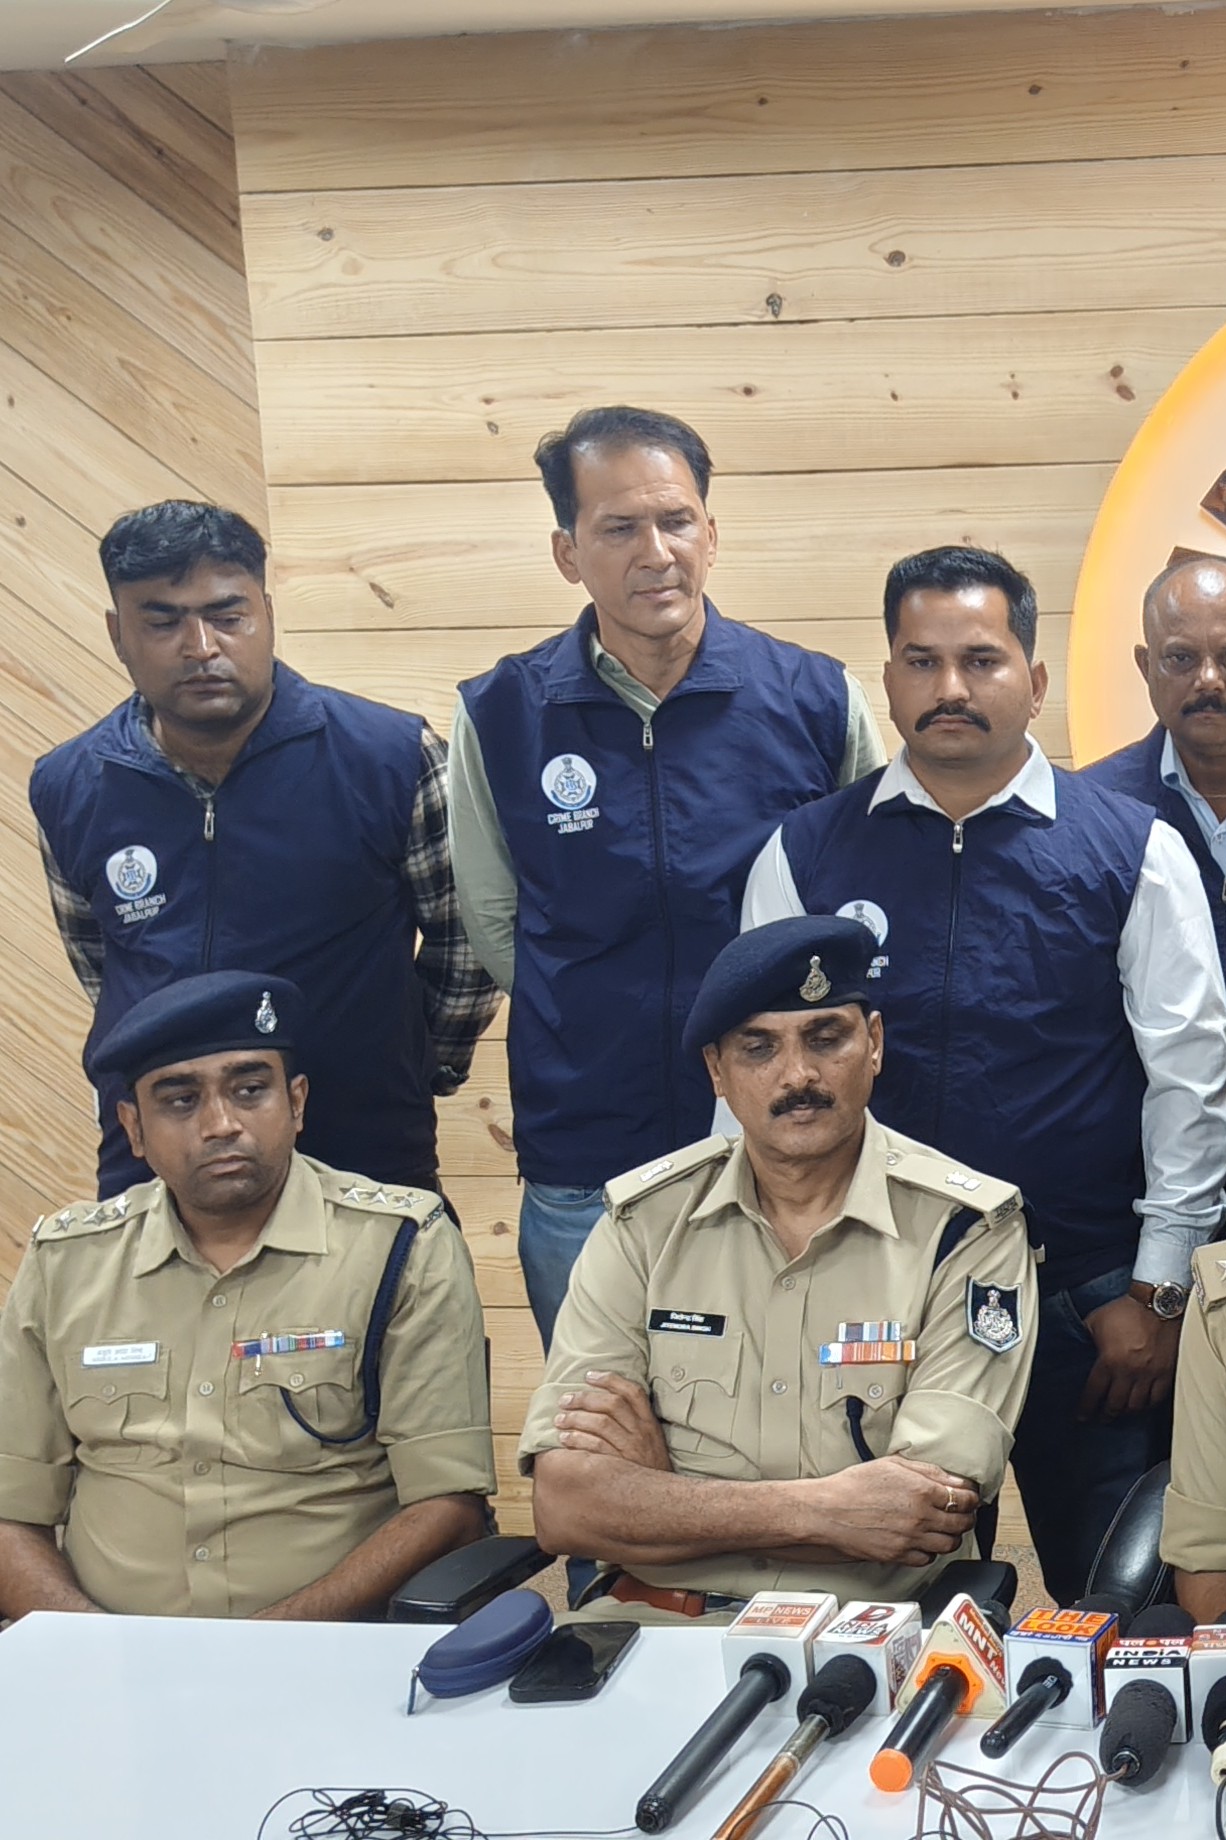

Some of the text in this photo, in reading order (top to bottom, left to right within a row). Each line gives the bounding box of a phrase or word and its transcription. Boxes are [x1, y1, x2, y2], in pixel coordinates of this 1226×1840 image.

[558, 819, 593, 834] JABALPUR
[752, 1605, 813, 1616] MP NEWS
[1034, 1609, 1108, 1624] THE
[756, 1617, 792, 1625] LIVE
[1020, 1620, 1095, 1634] LOOK
[959, 1612, 998, 1661] MNT
[1112, 1658, 1172, 1666] NEWS
